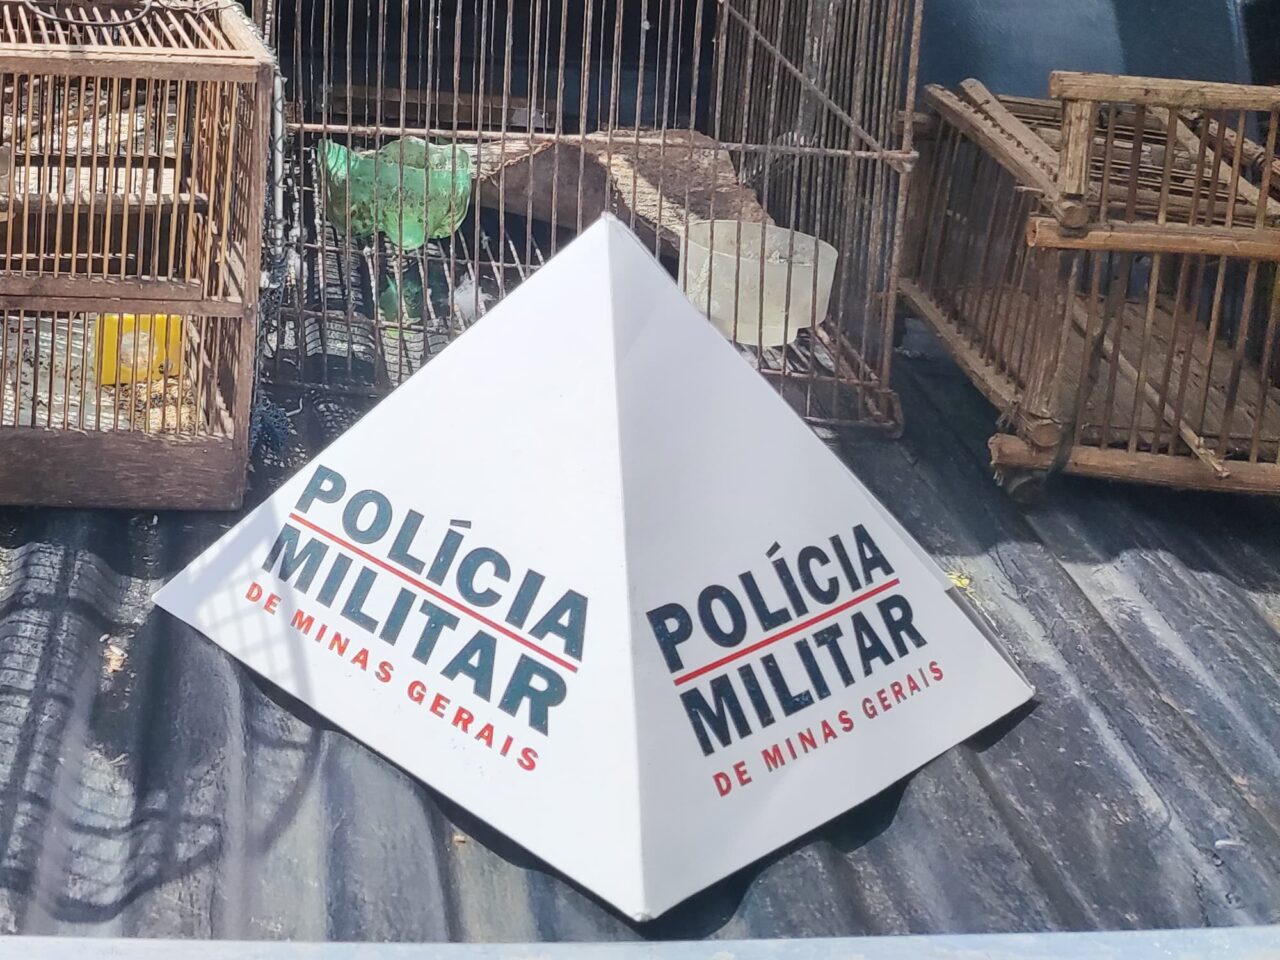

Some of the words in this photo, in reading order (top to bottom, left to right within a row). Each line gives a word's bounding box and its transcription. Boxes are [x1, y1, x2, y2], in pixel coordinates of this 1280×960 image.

[261, 522, 568, 737] MILITAR
[294, 464, 588, 662] POLÍCIA
[645, 523, 896, 674] POLÍCIA
[245, 582, 282, 615] DE
[290, 608, 395, 684] MINAS
[407, 680, 539, 772] GERAIS
[679, 593, 928, 757] MILITAR
[712, 760, 753, 797] DE
[760, 709, 855, 773] MINAS
[861, 660, 944, 720] GERAIS
